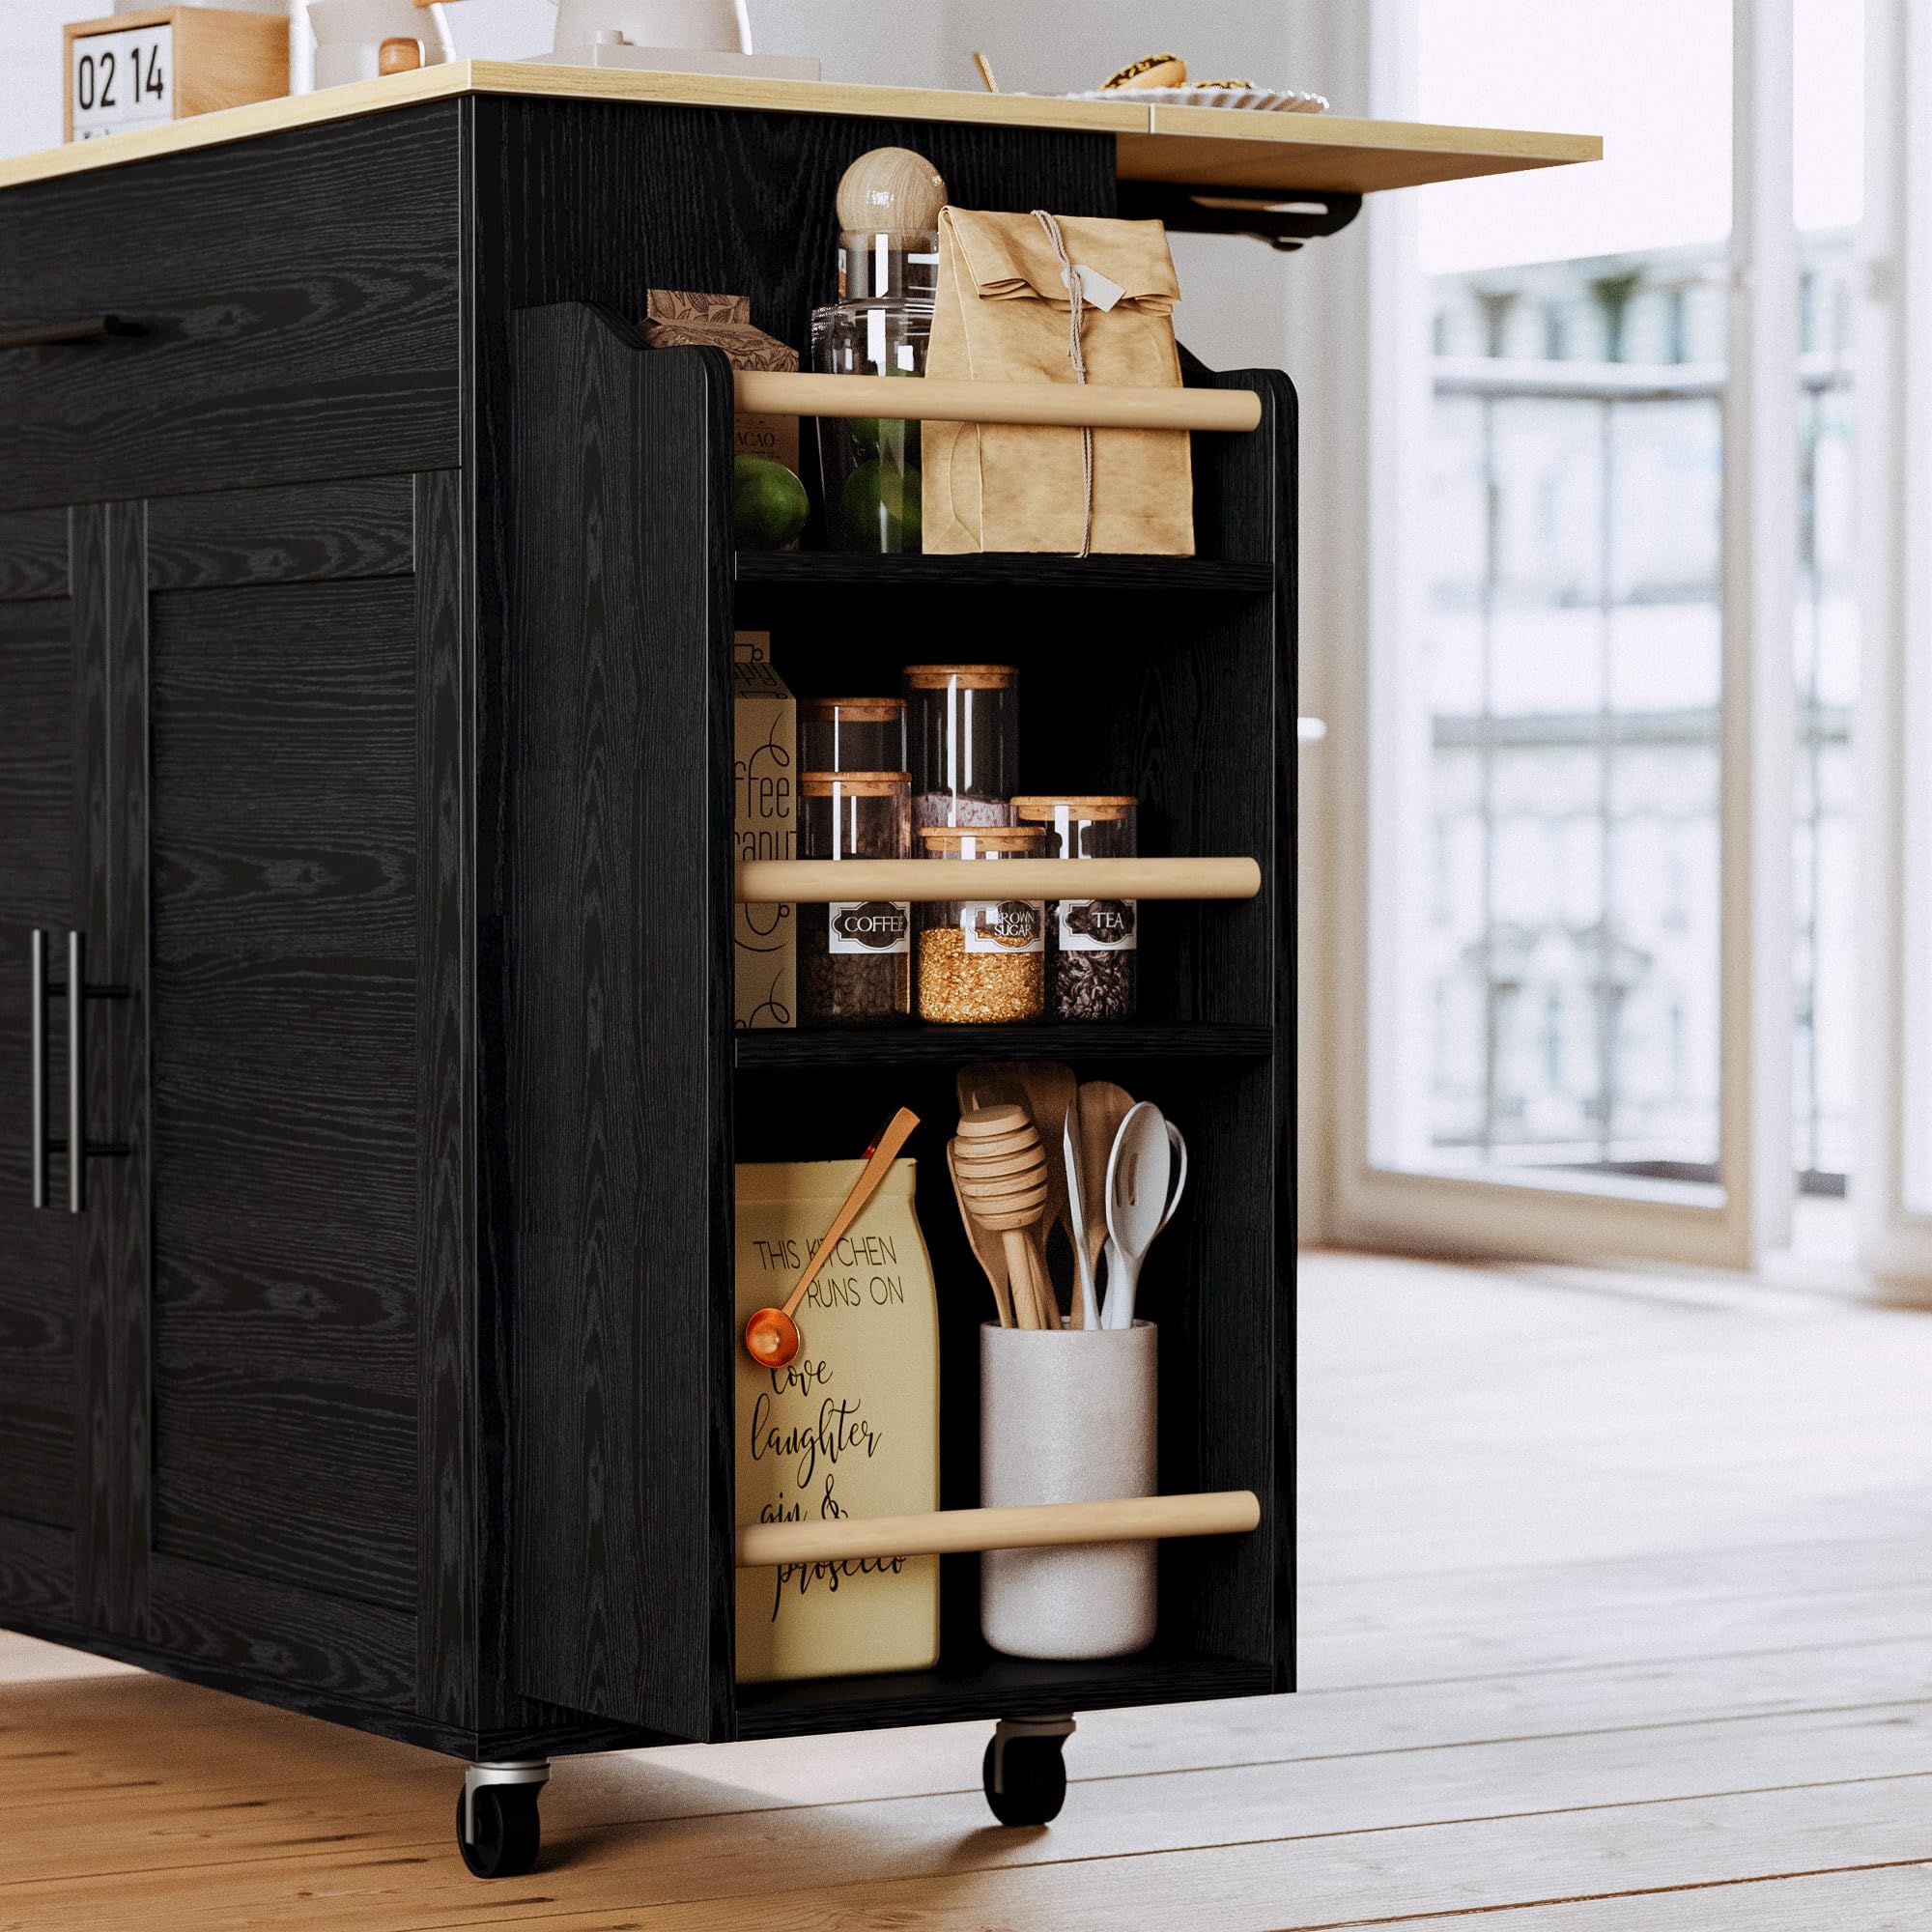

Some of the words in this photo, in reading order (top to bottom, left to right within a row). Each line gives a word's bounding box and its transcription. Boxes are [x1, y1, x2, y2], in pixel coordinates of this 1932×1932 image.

[78, 51, 116, 110] 02
[130, 44, 164, 103] 14
[993, 923, 1035, 938] SUGAR
[995, 911, 1036, 925] ROWN
[1091, 912, 1125, 929] TEA
[753, 1239, 801, 1271] THIS
[807, 1276, 861, 1309] RUNS
[869, 1275, 904, 1306] ON
[751, 1392, 883, 1490] laughter
[821, 1473, 849, 1520] &
